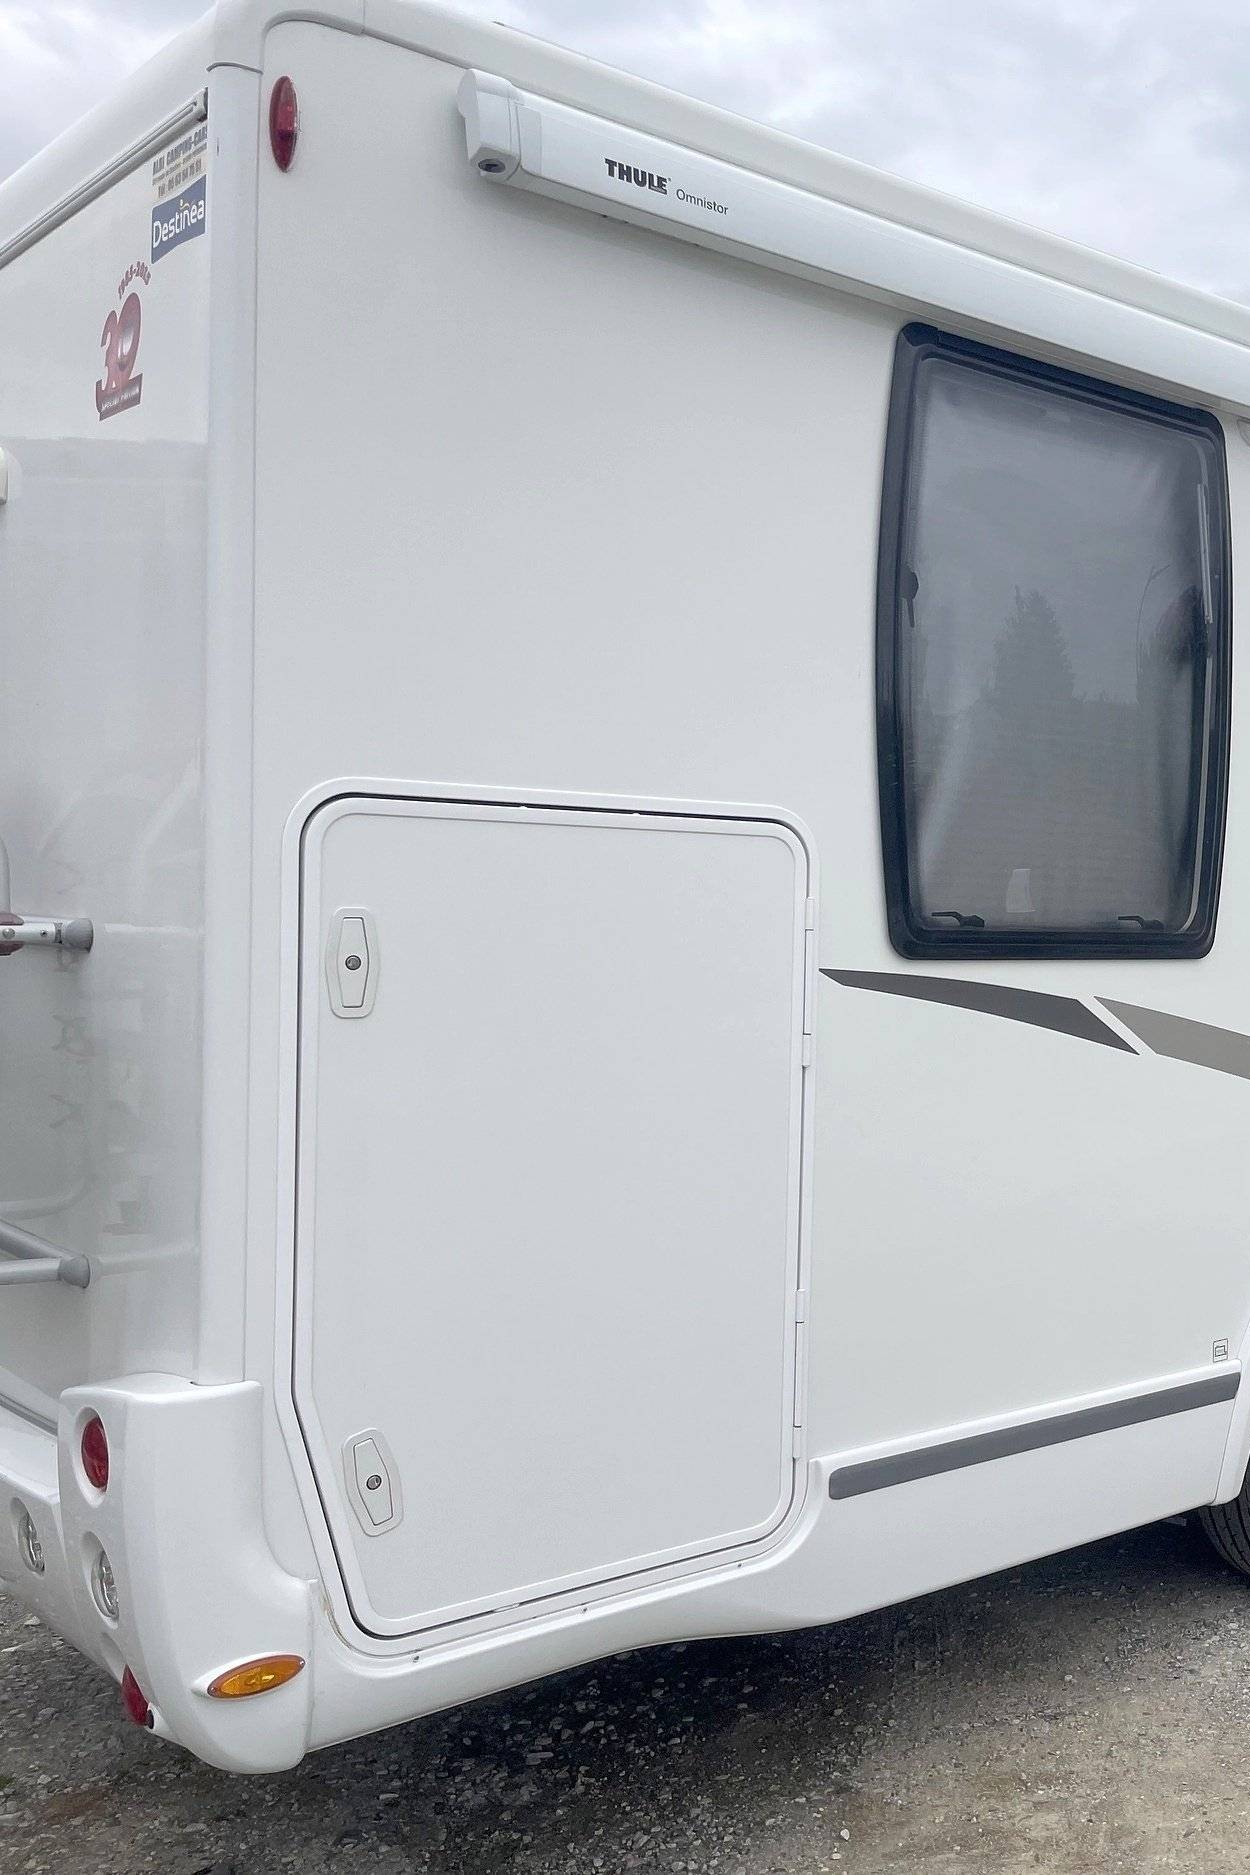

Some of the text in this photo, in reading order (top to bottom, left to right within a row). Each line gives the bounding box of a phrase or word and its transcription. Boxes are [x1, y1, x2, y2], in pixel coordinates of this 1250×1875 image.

[604, 158, 729, 215] THULE Omnistor
[153, 200, 205, 248] Destinea
[96, 292, 142, 412] 30
